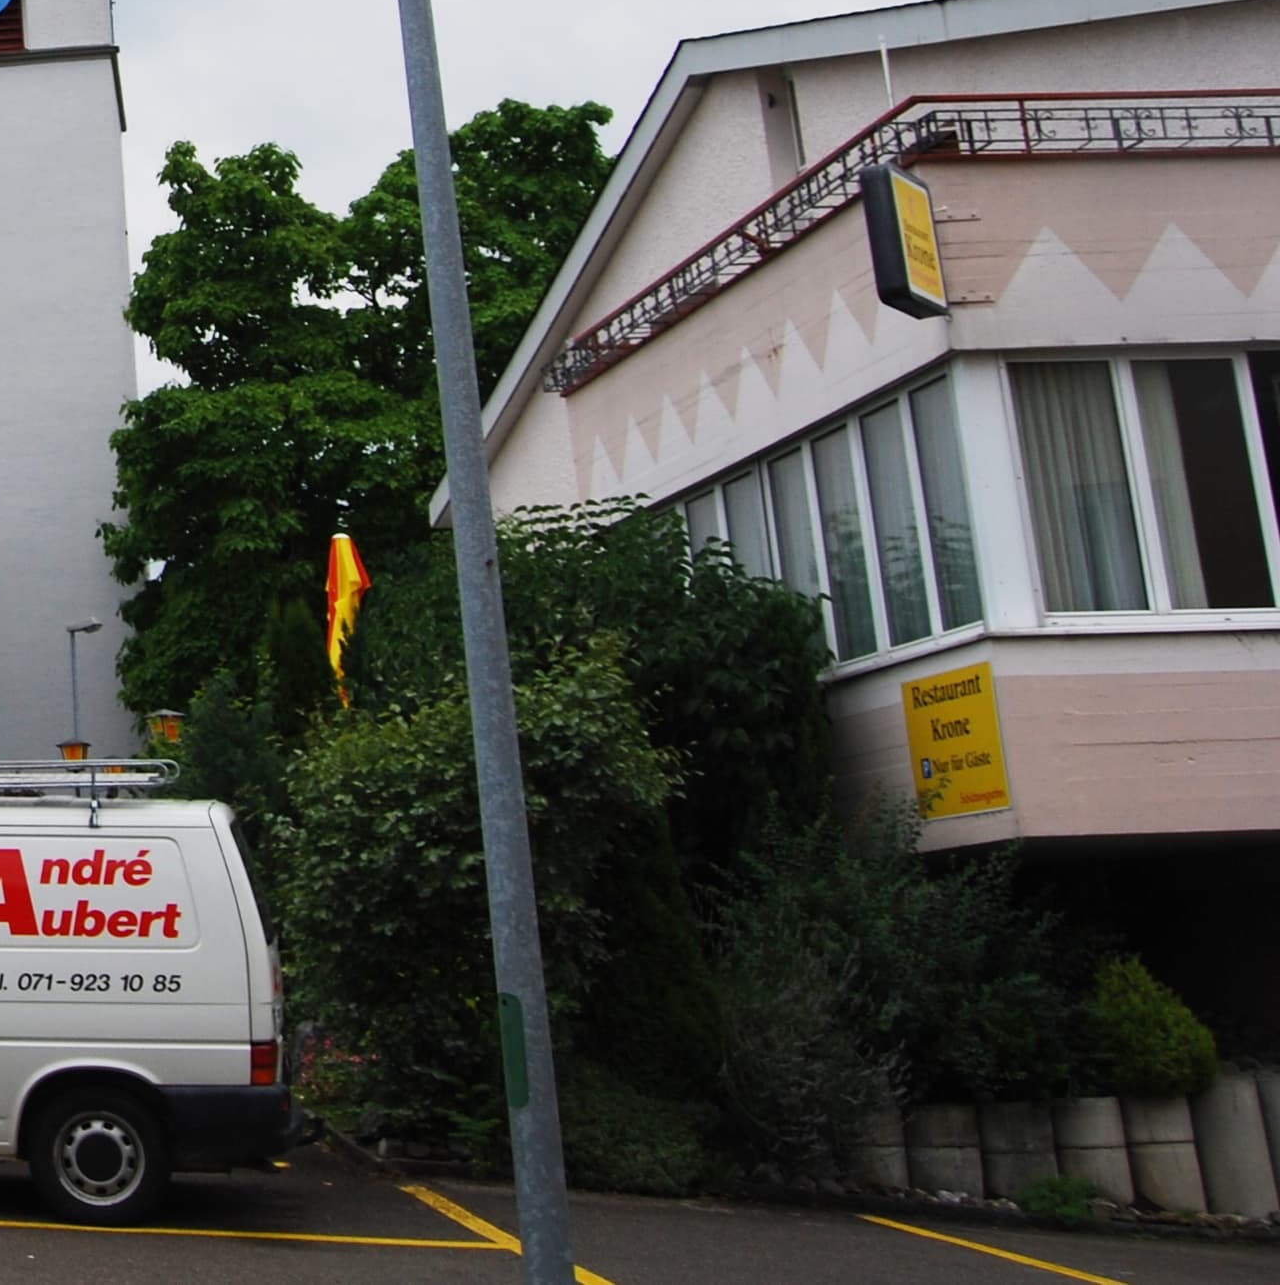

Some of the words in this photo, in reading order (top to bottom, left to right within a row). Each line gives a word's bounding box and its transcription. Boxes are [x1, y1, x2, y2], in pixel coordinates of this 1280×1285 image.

[911, 674, 982, 709] Restaurant
[930, 718, 972, 742] Krone
[17, 972, 111, 992] 071-923
[120, 974, 144, 992] 10
[153, 974, 181, 993] 85
